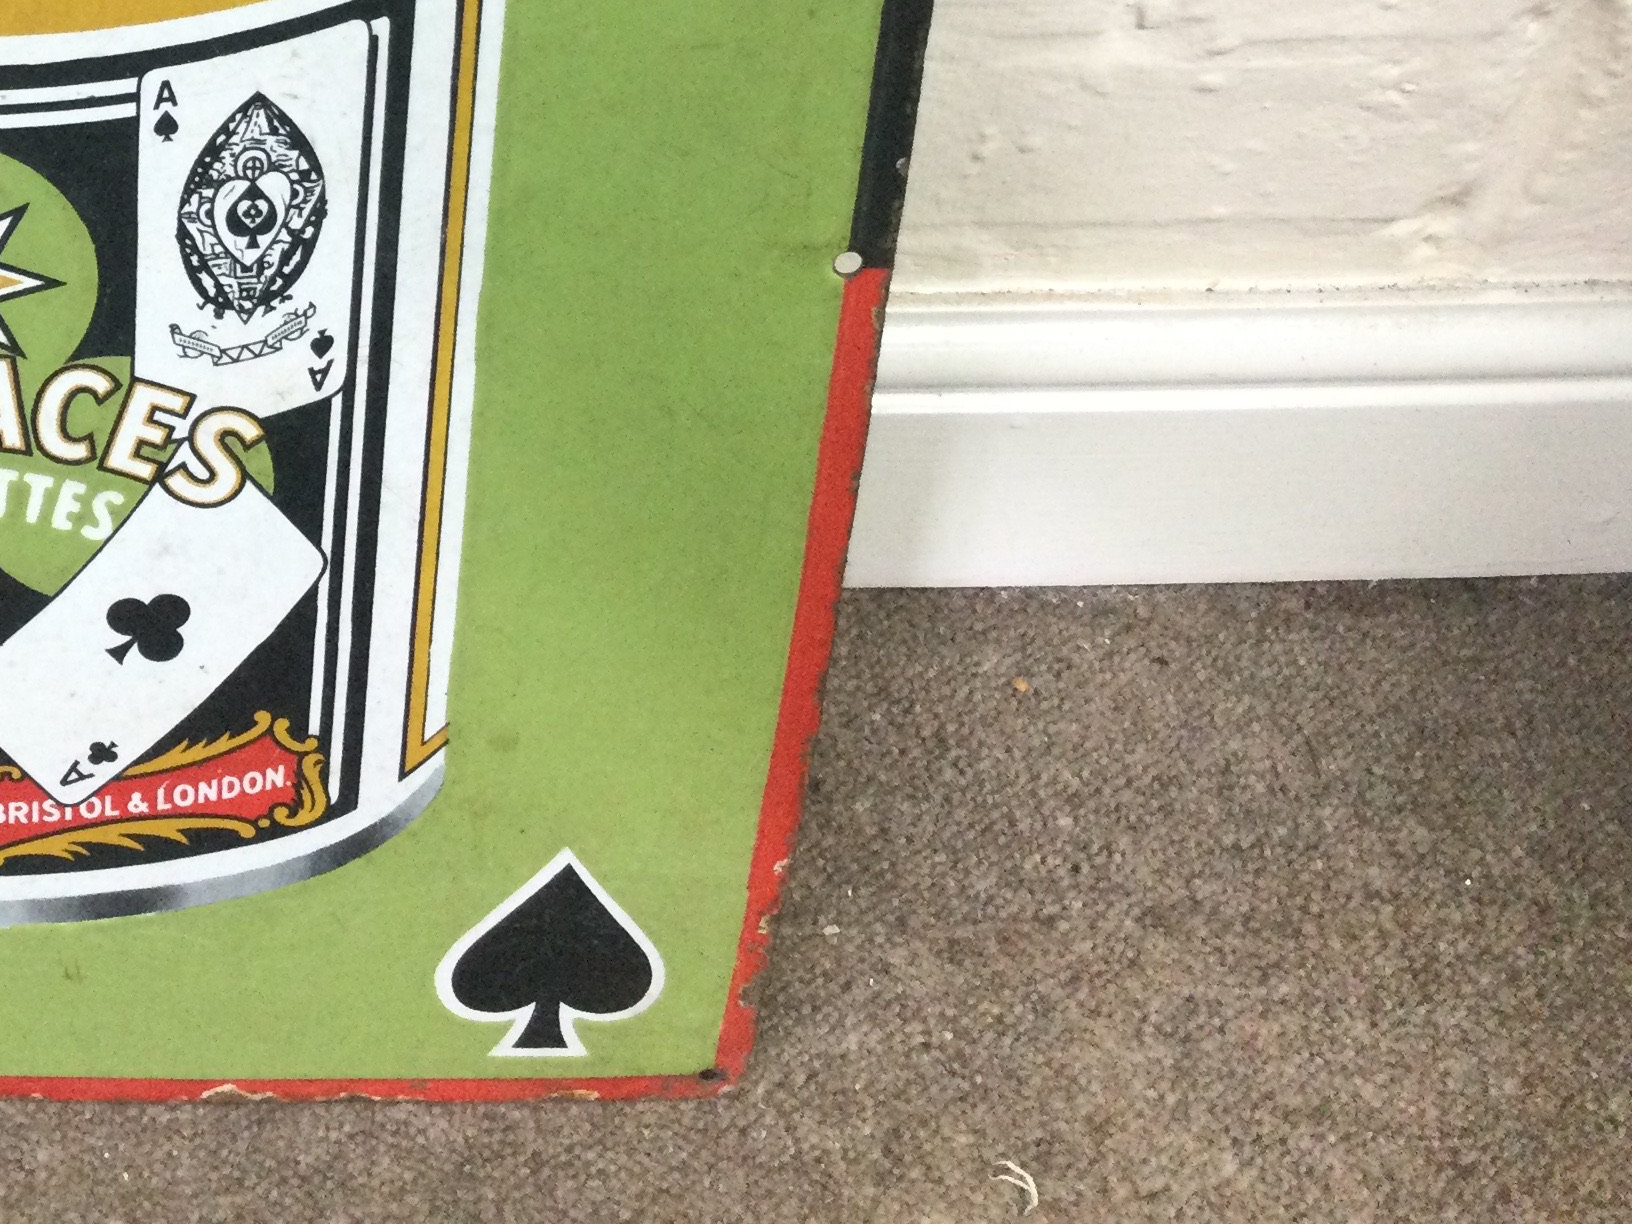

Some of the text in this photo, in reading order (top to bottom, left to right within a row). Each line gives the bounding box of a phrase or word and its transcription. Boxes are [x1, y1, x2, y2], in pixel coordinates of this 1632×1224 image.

[153, 80, 178, 110] A
[308, 359, 334, 392] A
[59, 759, 96, 788] A
[127, 790, 150, 815] &
